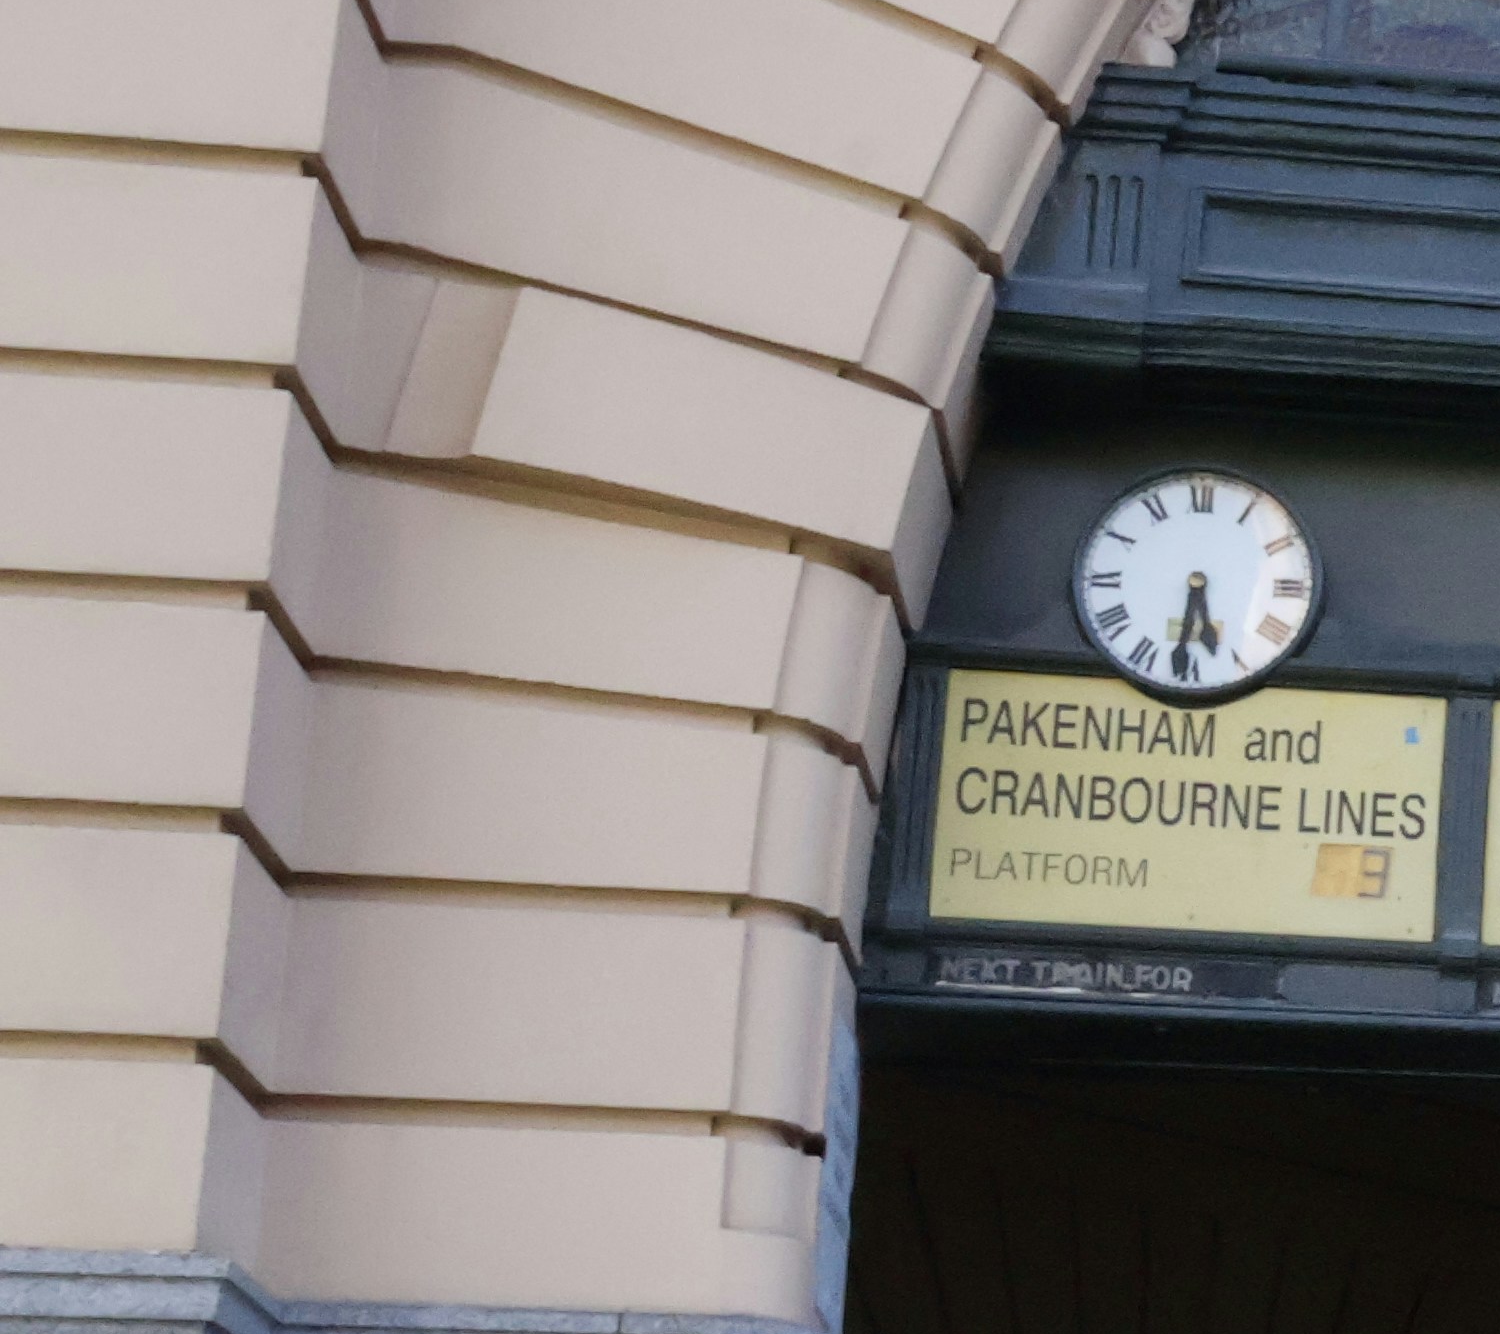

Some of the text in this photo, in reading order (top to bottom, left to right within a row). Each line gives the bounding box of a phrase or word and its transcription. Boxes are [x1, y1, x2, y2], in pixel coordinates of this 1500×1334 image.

[960, 698, 1322, 764] PAKENHAM and
[955, 766, 1427, 840] CRANBOURNE LINES
[948, 847, 1392, 899] PLATFORM 3
[939, 955, 1194, 994] NEXT TRAIN FOR
